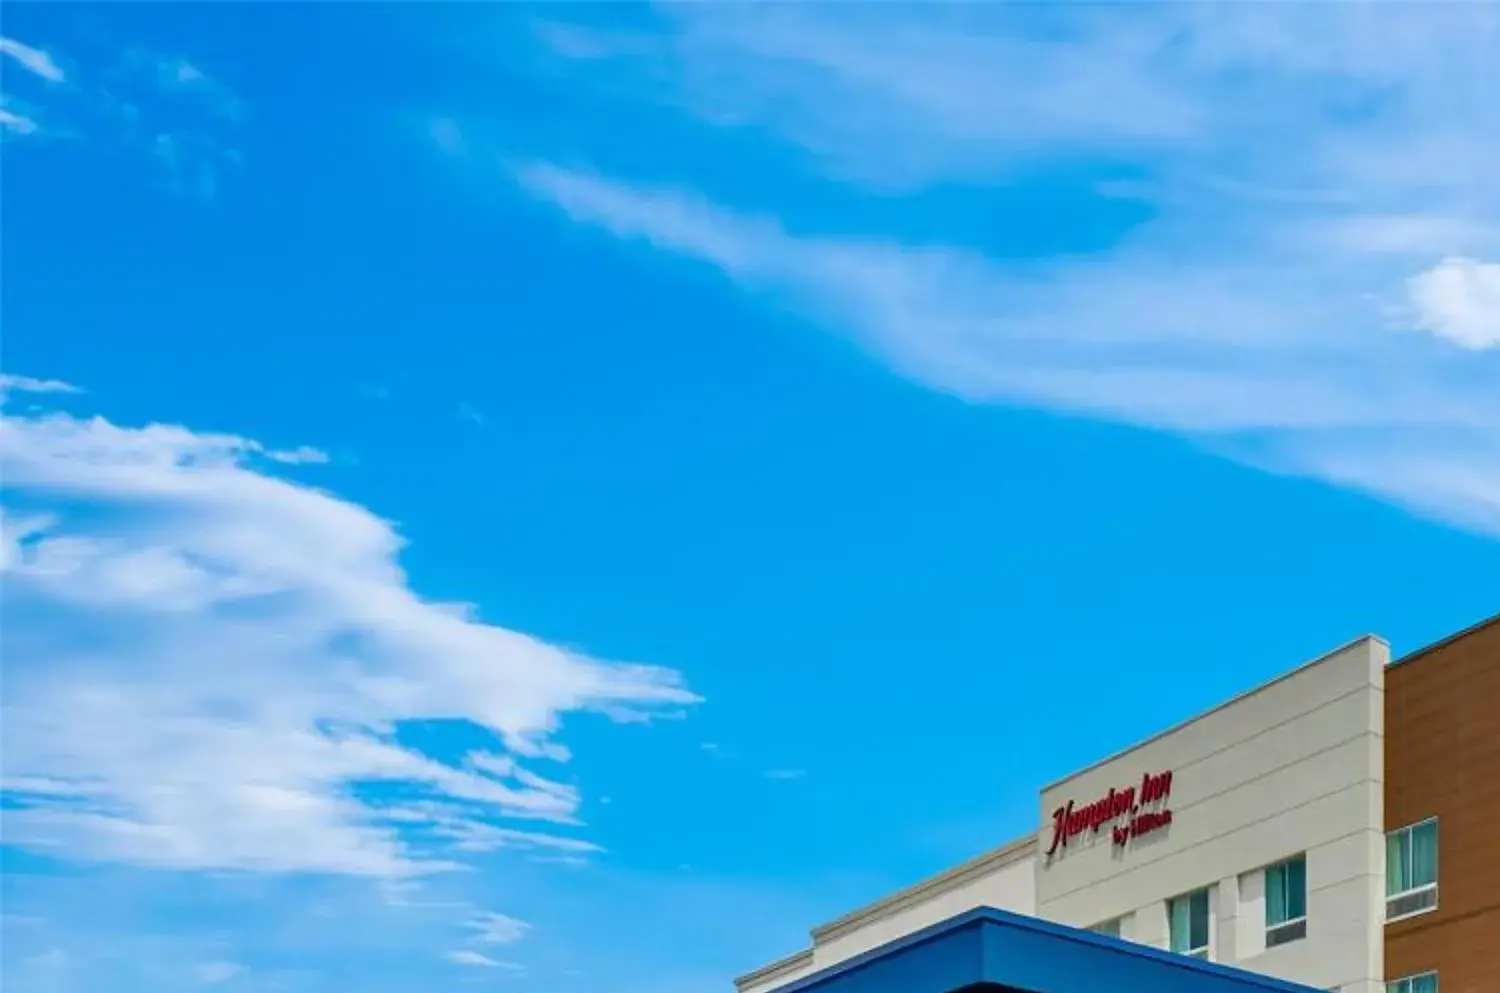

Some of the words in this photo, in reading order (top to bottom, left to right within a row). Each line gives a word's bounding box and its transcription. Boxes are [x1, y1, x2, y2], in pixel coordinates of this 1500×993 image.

[1045, 787, 1136, 854] Hampton
[1139, 769, 1172, 806] Inn
[1113, 825, 1129, 847] by
